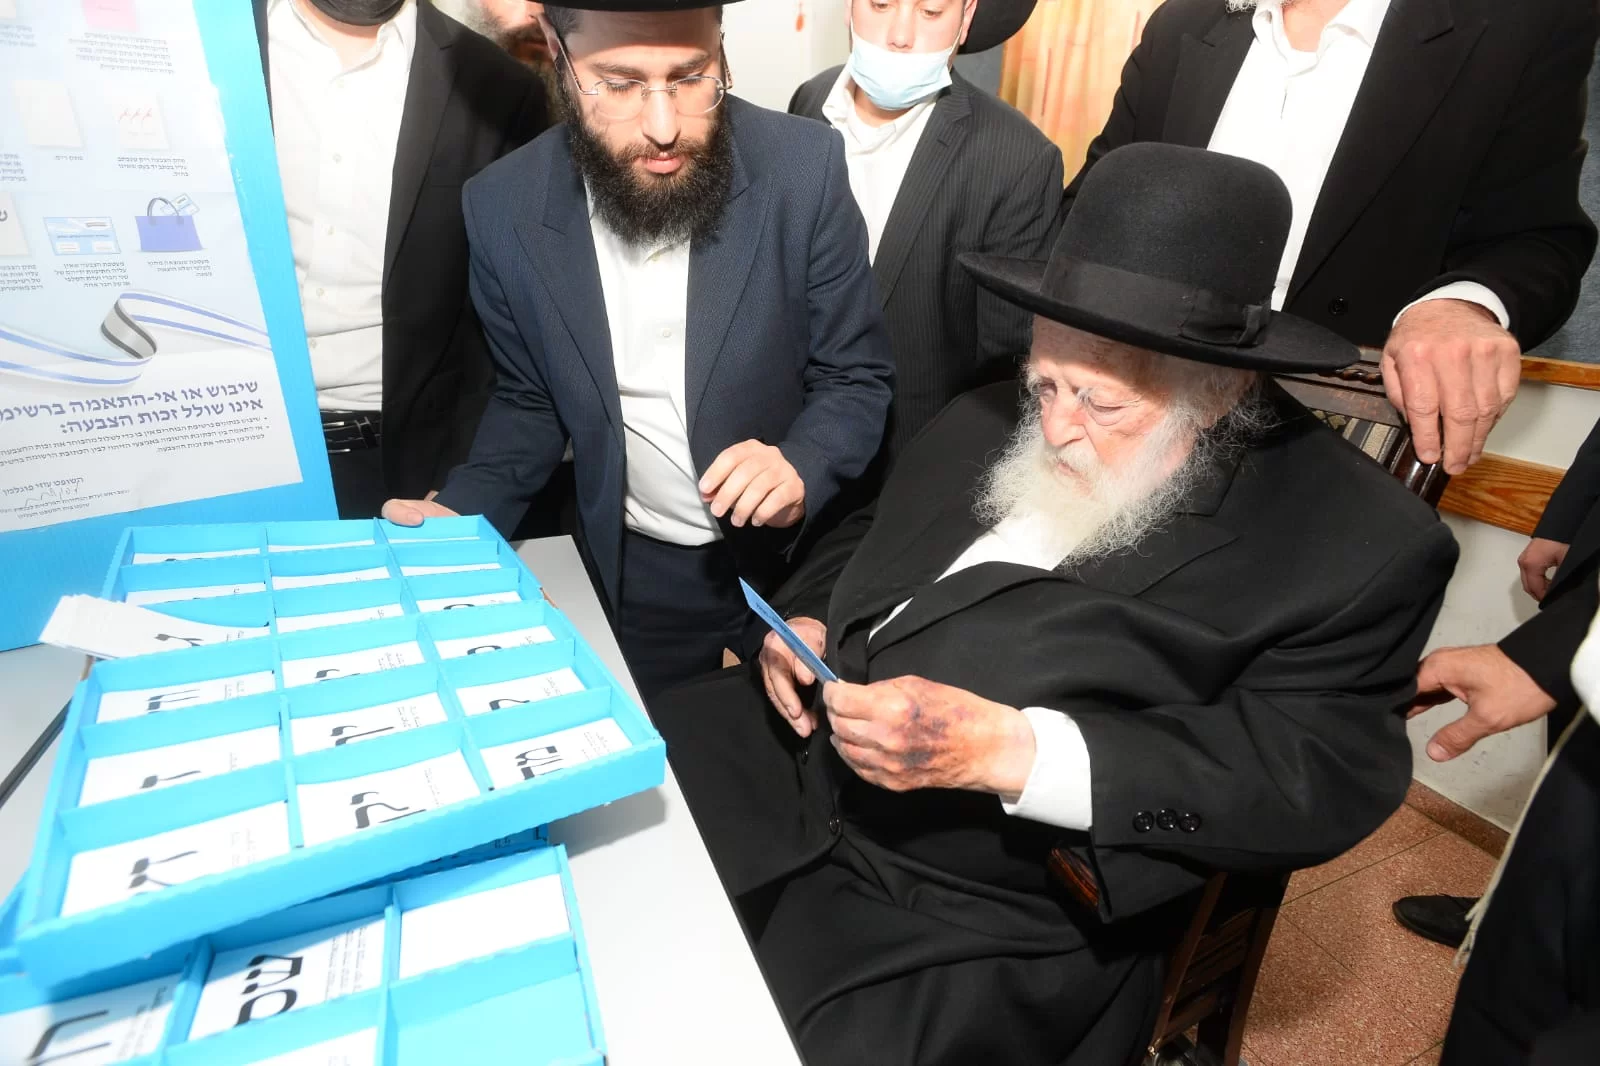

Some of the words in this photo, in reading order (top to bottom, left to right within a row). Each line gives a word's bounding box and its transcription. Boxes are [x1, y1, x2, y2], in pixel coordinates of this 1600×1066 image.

[180, 387, 203, 401] או
[206, 380, 258, 398] שיבוש
[69, 389, 178, 413] אי-התאמה
[181, 401, 225, 418] שולל
[228, 398, 264, 413] אינו
[0, 403, 66, 421] ברשימ
[137, 408, 178, 424] זכות
[60, 415, 134, 434] הצבעה:
[53, 476, 84, 487] השופט
